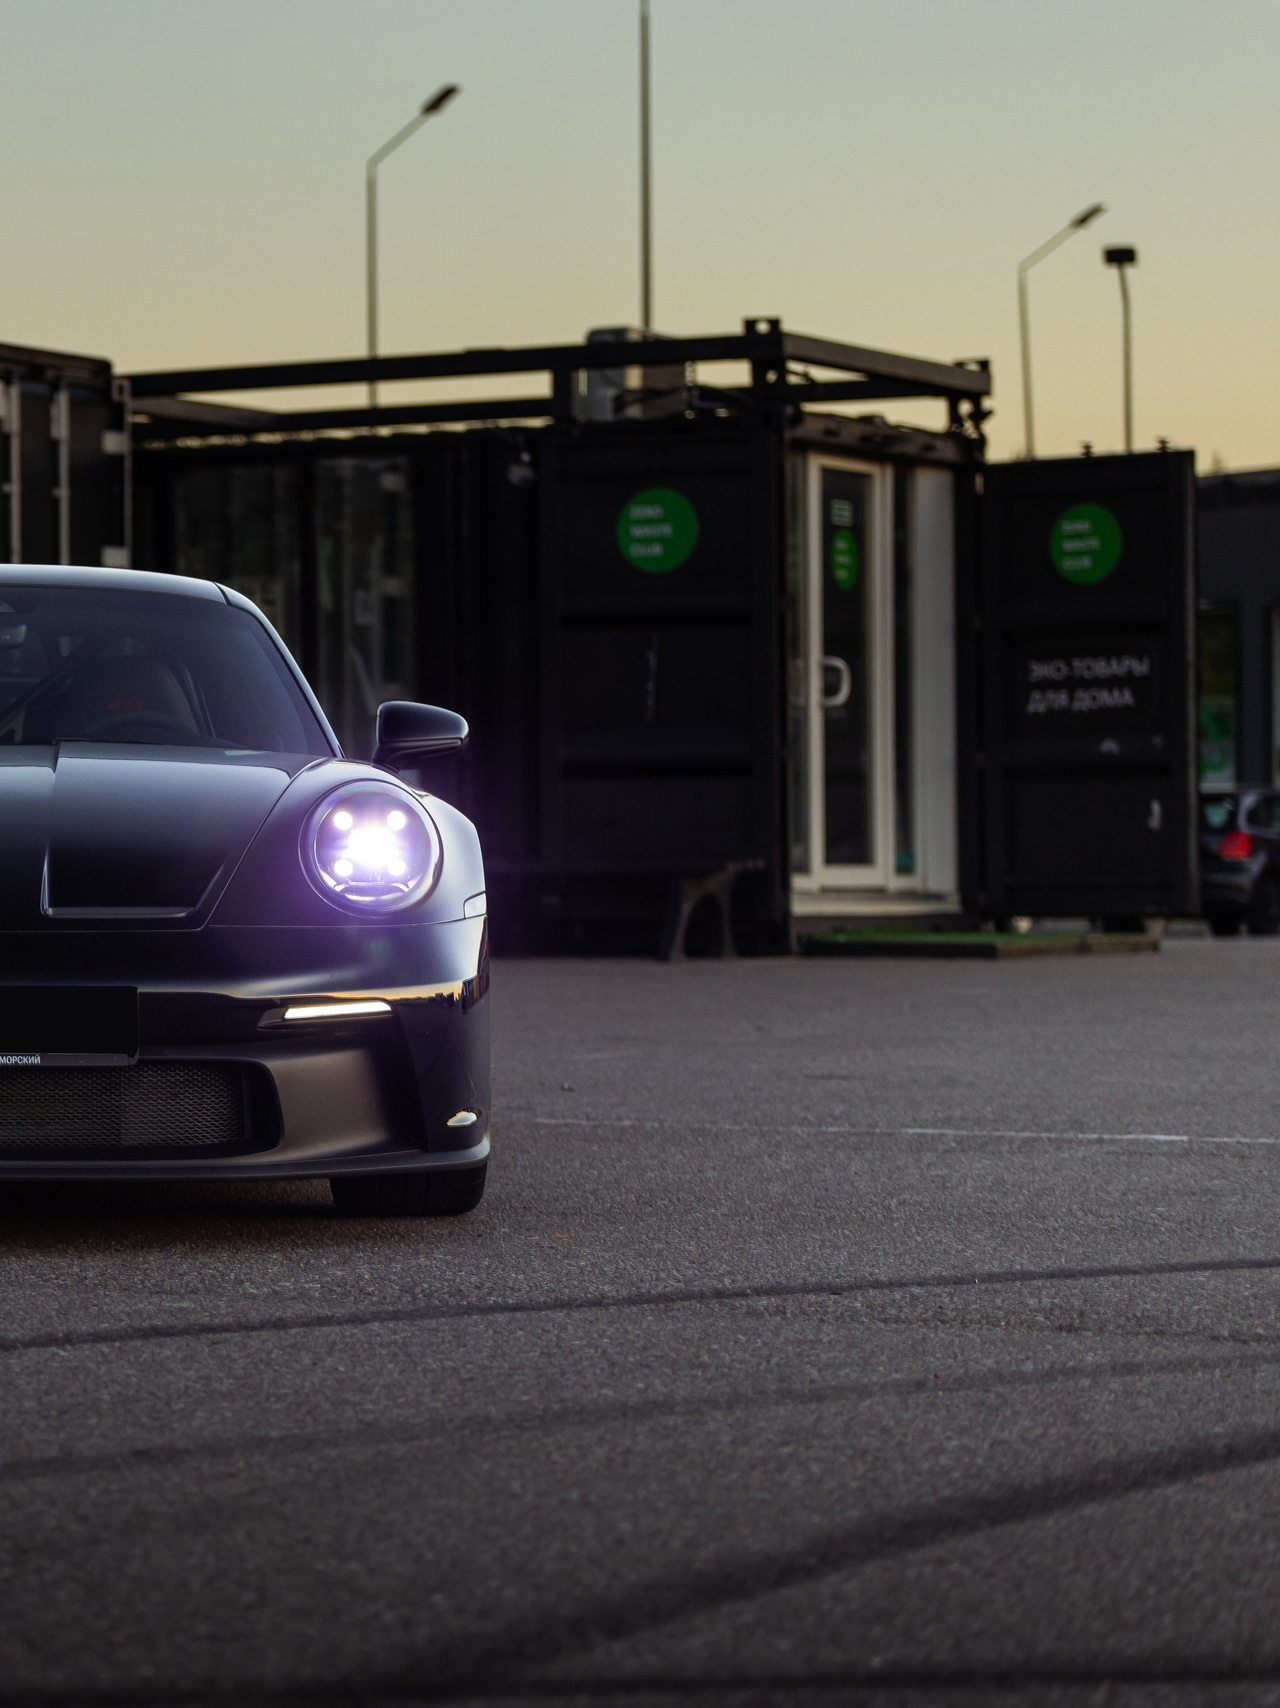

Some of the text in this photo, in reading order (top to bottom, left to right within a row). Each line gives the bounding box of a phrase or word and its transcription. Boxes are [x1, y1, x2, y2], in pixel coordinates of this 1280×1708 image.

[1027, 654, 1151, 682] ЭКО-ТОВАРЫ
[1026, 686, 1136, 716] ДЛЯ ДОМА
